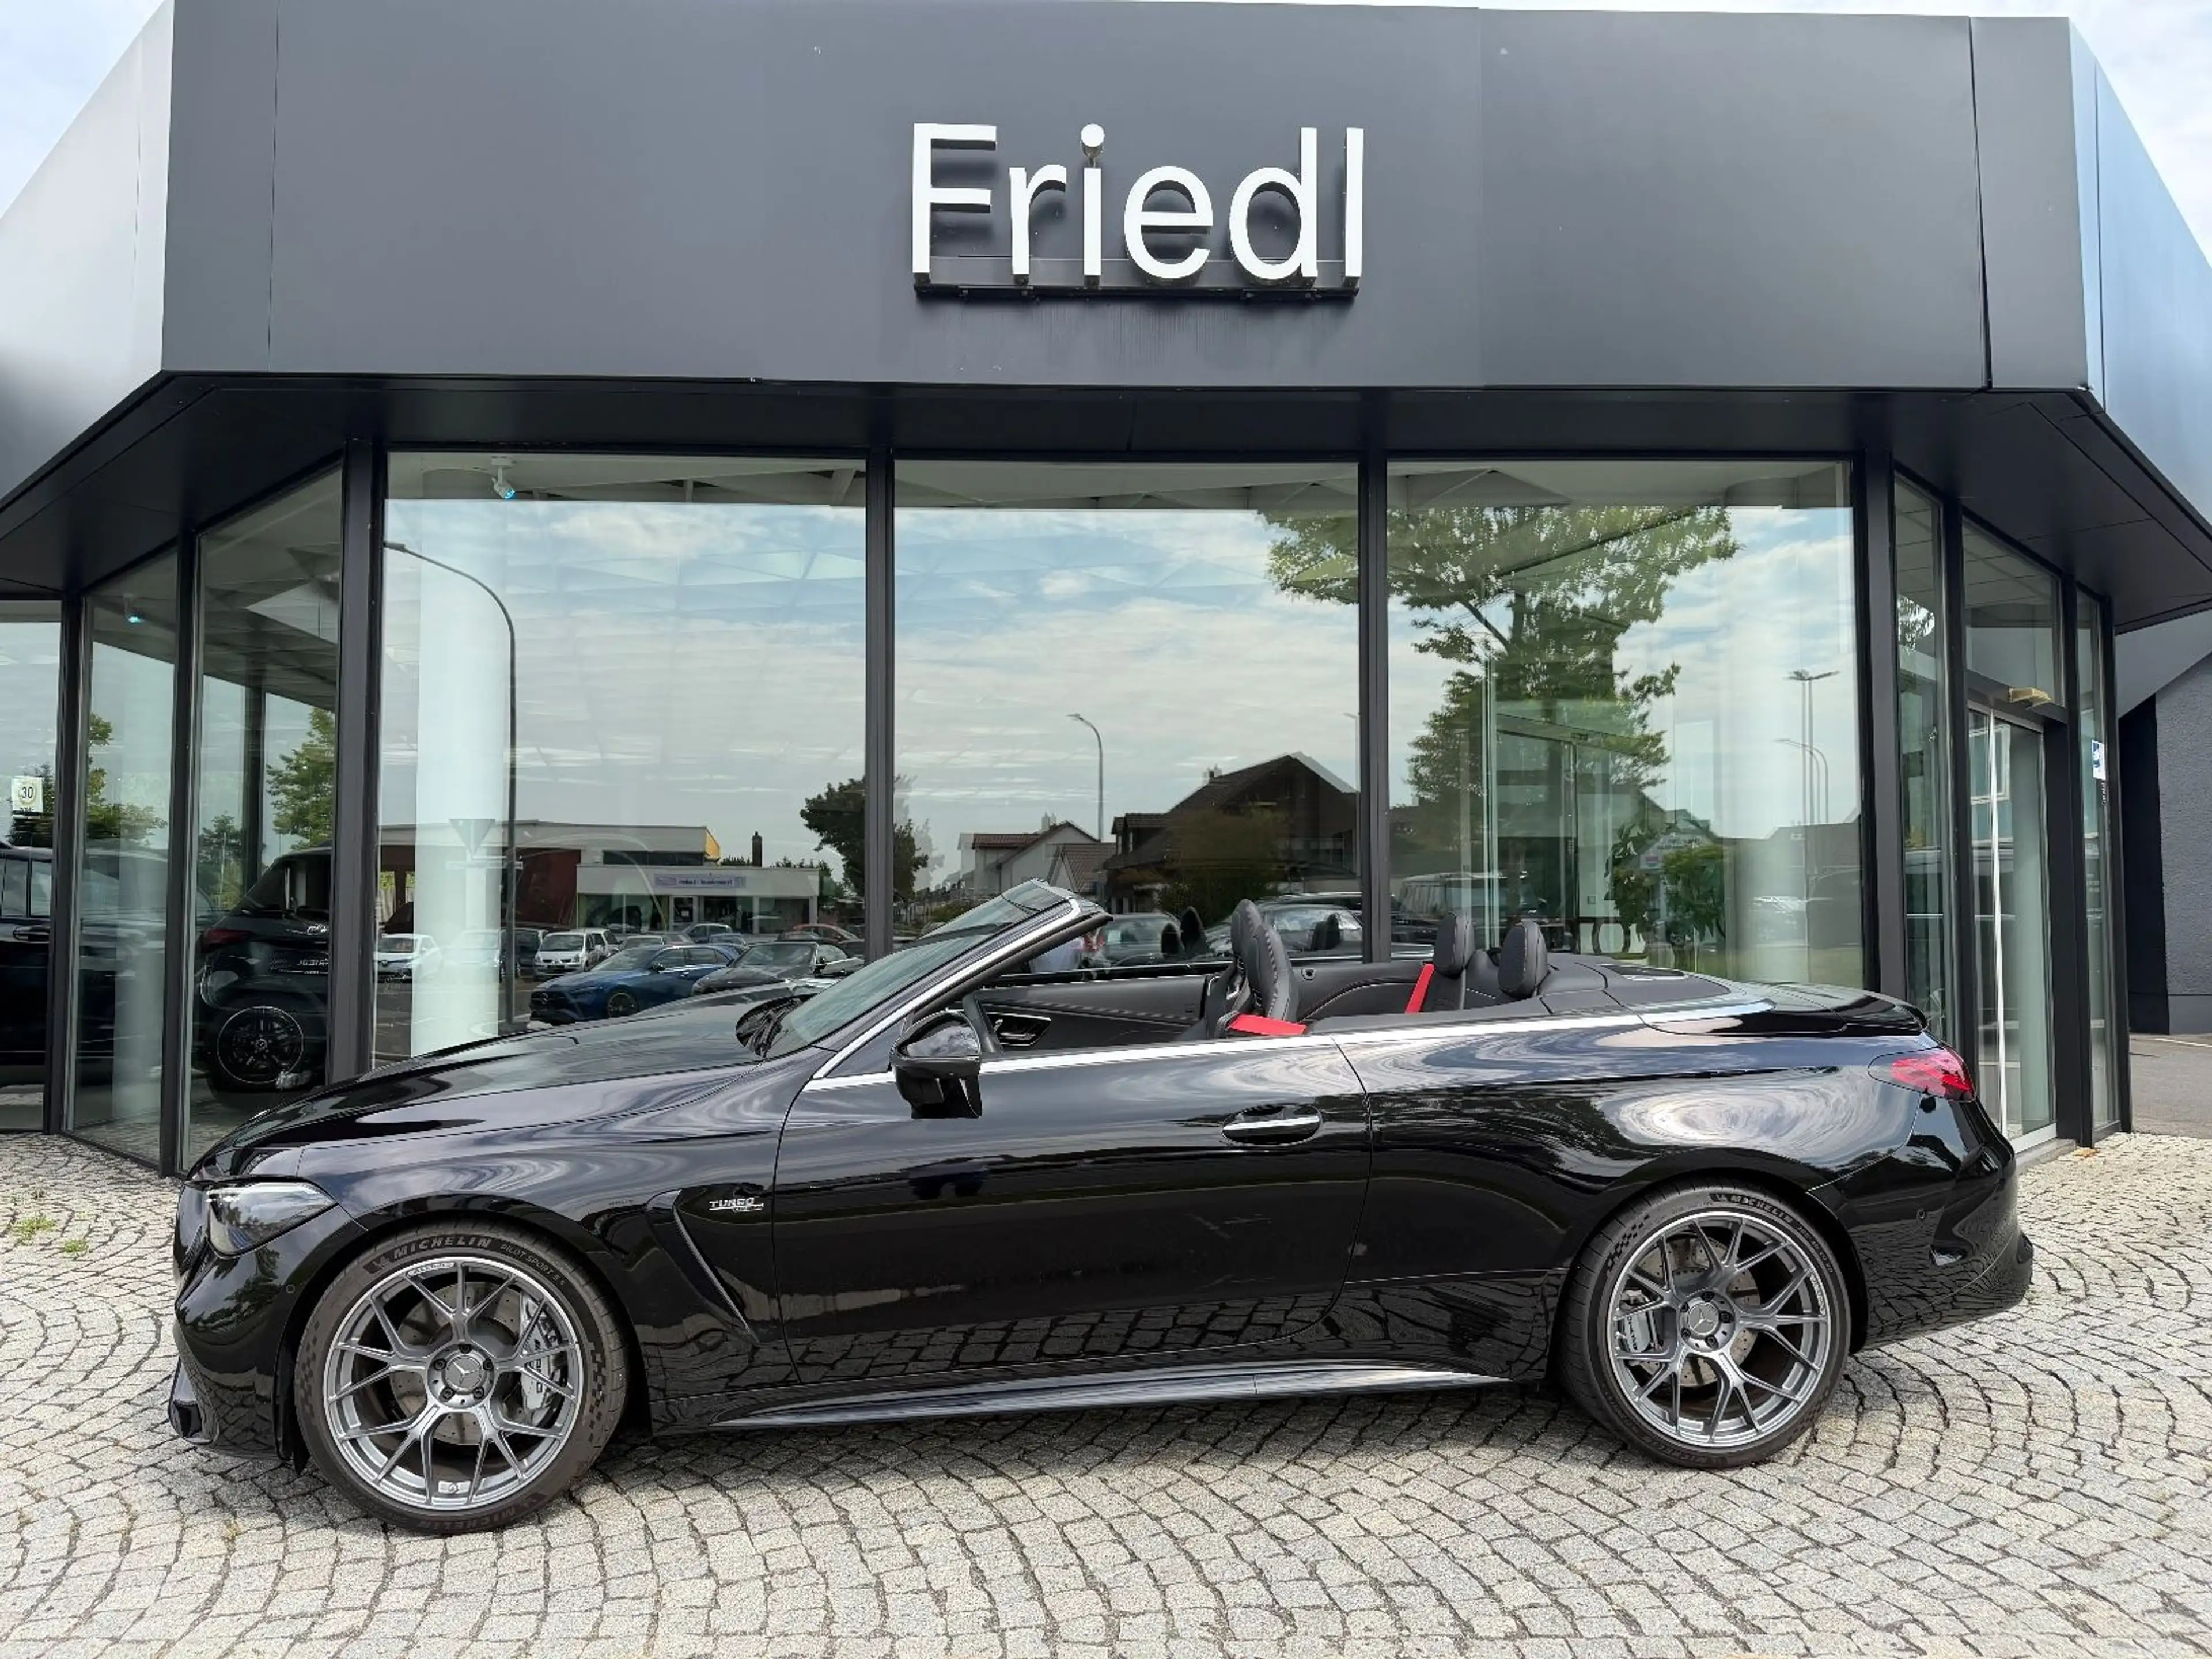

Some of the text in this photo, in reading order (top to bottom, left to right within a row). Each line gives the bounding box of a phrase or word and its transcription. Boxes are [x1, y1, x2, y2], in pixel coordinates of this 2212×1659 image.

[912, 123, 1364, 280] Friedl
[21, 786, 34, 798] 30
[1730, 1194, 1793, 1224] MICHELIN
[393, 1236, 491, 1260] MICHELIN
[500, 1244, 527, 1258] PILOT
[525, 1255, 554, 1274] SPORT
